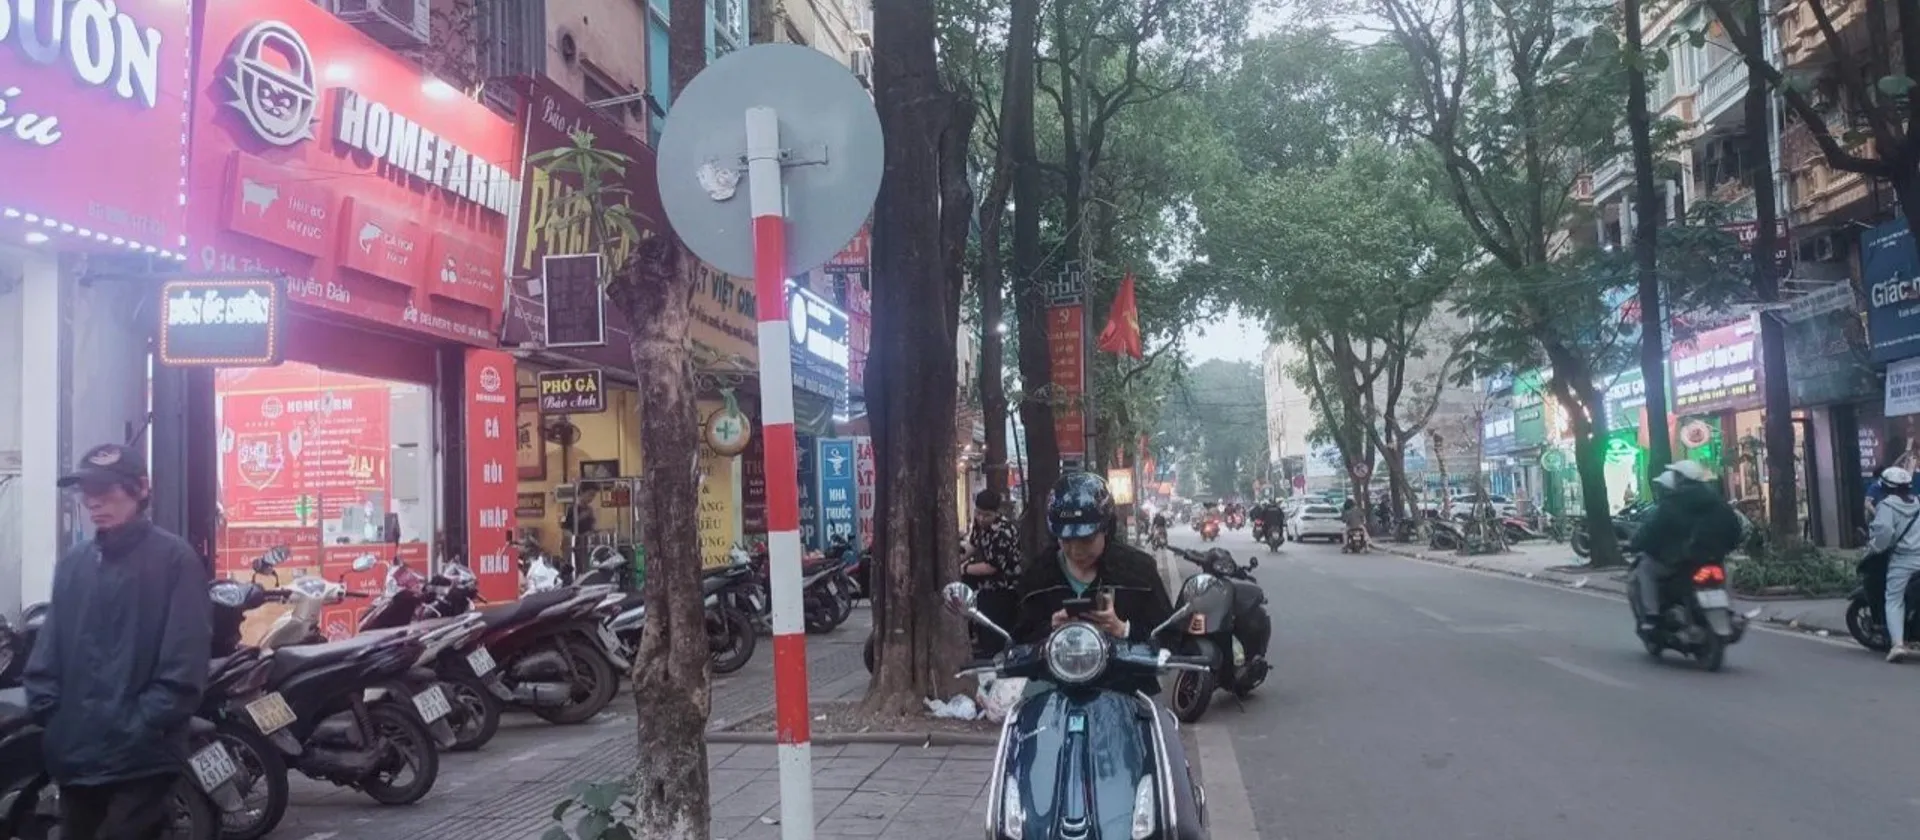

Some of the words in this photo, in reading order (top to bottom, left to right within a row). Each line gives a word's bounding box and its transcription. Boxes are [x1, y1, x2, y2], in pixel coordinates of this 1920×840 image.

[339, 92, 519, 217] HOMEFARM
[1871, 271, 1907, 309] Giấc
[541, 373, 573, 395] PHỞ
[569, 393, 597, 408] Anh
[484, 415, 500, 438] CÁ
[479, 506, 508, 532] NHẬP
